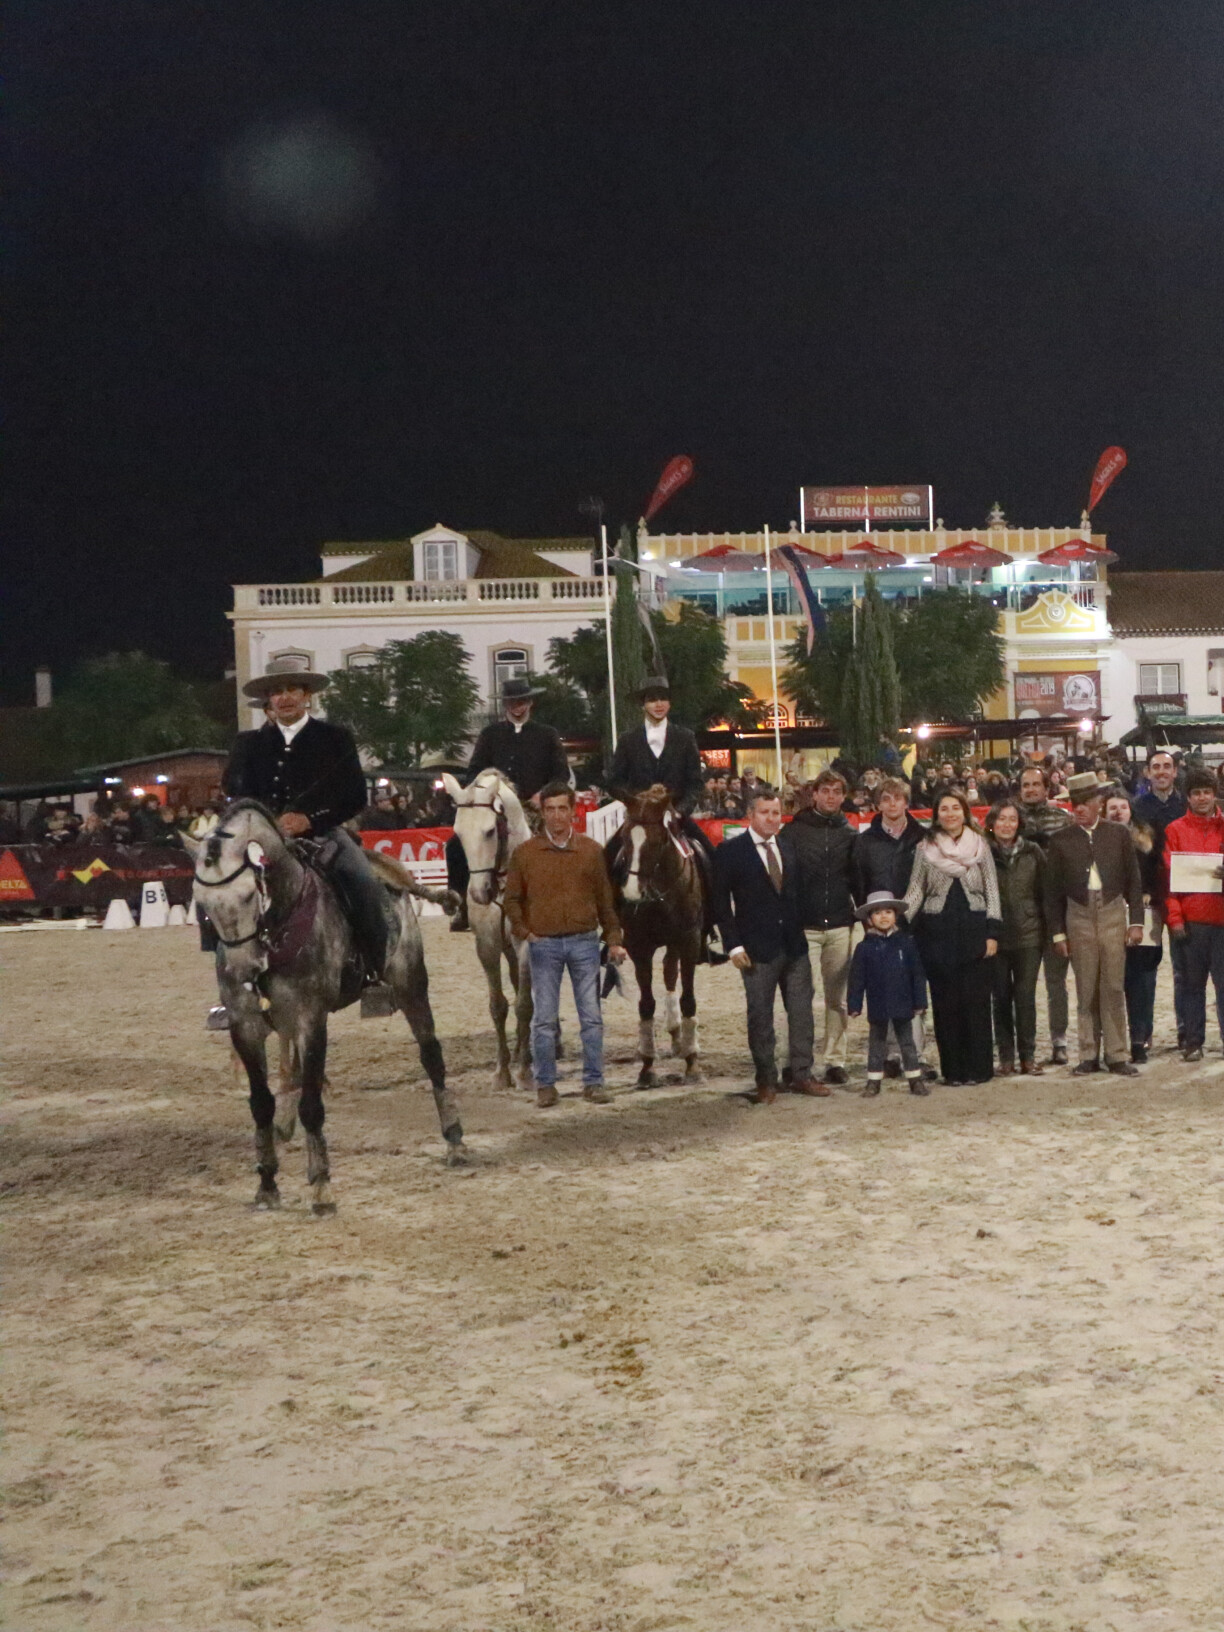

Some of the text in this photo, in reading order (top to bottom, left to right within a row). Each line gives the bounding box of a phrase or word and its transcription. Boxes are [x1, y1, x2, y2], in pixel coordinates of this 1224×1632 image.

[836, 495, 898, 504] RESTAURANTE
[813, 506, 921, 518] TABERNA RENTINI
[0, 879, 28, 889] ELTA
[145, 890, 157, 904] B
